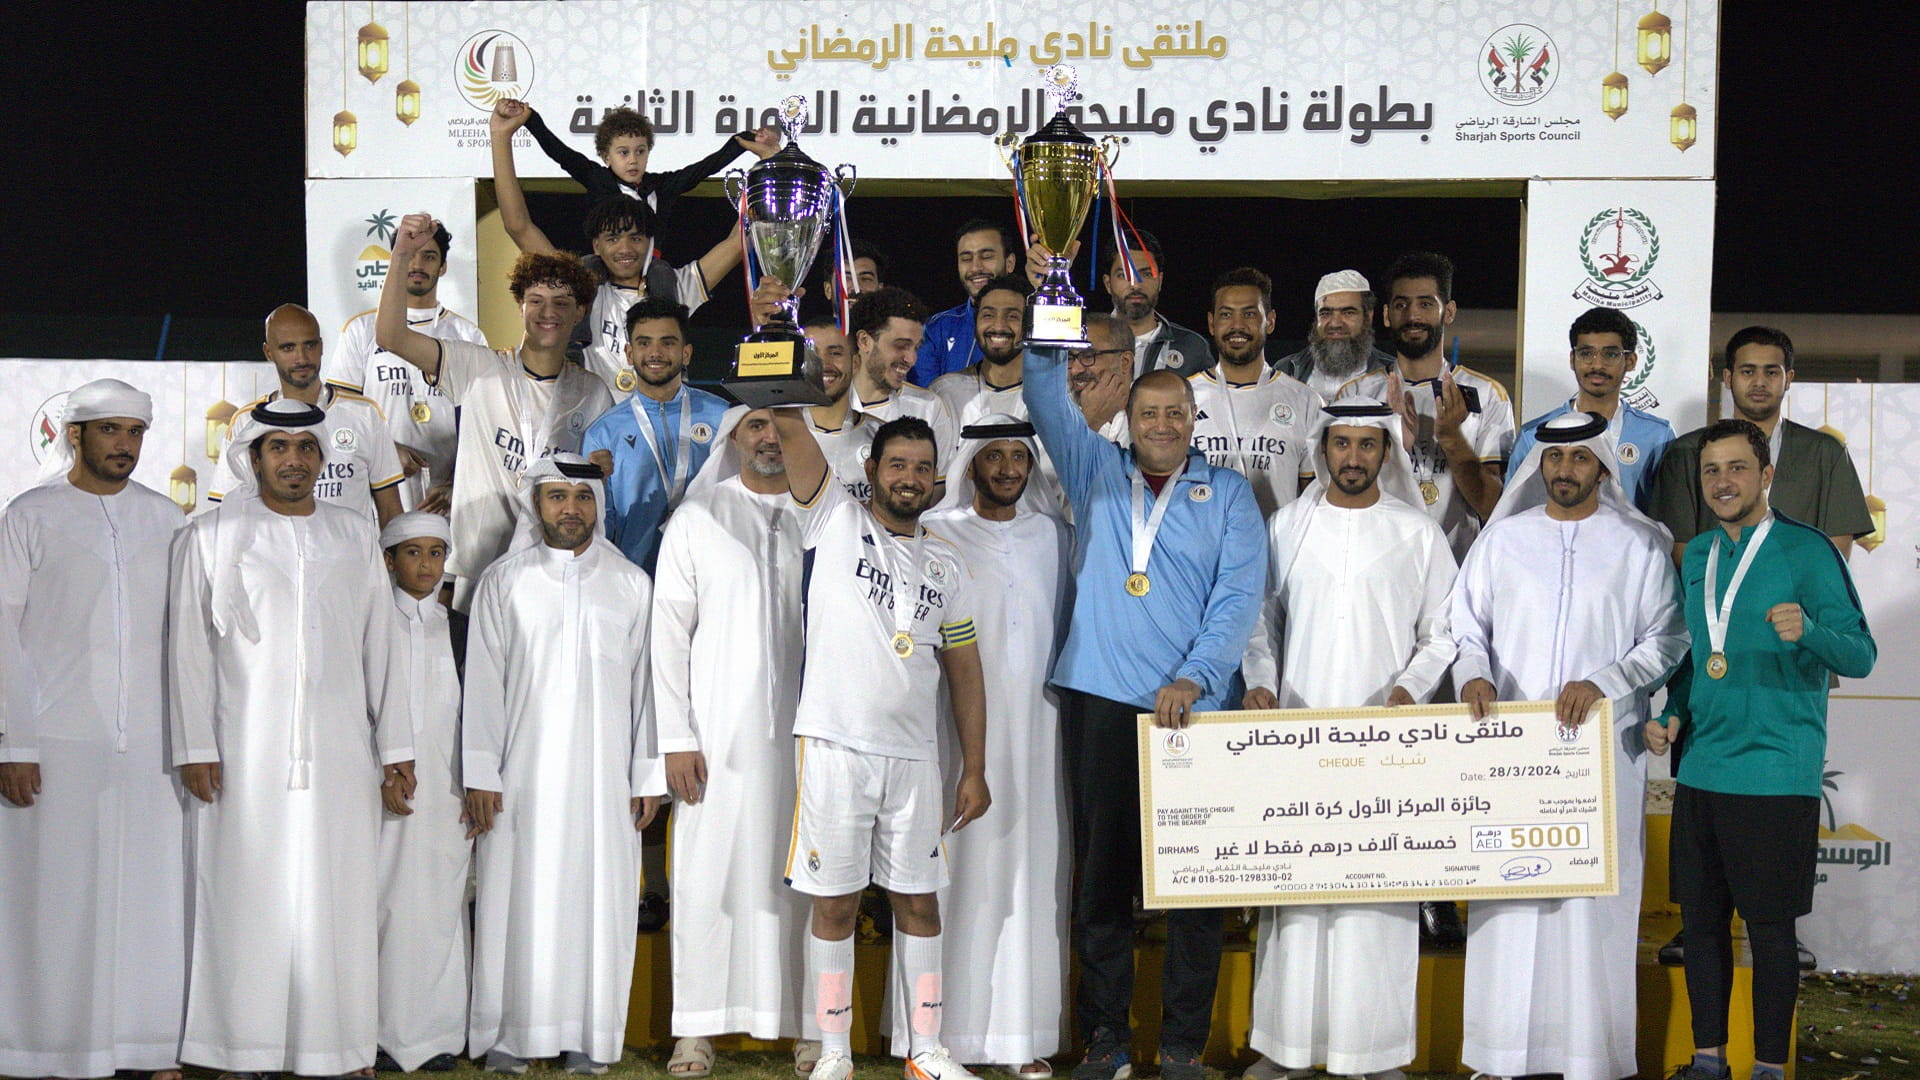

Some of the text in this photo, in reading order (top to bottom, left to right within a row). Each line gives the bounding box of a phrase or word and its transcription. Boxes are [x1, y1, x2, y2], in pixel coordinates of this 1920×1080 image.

[767, 20, 1229, 81] ملتقى نادي مليحة الرمضاني
[852, 88, 1046, 146] الرمضانية
[1188, 86, 1289, 154] نادي
[1303, 85, 1433, 145] بطولة
[1455, 116, 1580, 130] مجلس الشارقة الرياضي
[448, 129, 487, 138] MLEEHA
[1455, 131, 1580, 143] Sharjah Sports Council
[457, 140, 532, 148] & SPOR LUB
[390, 382, 407, 396] FLY
[1193, 434, 1287, 455] Emrtes
[504, 454, 522, 473] FLY
[314, 482, 343, 498] TTER
[1226, 721, 1524, 756] ملتقى نادي مليحة الرمضاني
[1318, 757, 1366, 768] CHEQUE
[1460, 765, 1561, 781] Date: 28/3/2024
[1565, 768, 1590, 780] التاريخ
[1263, 796, 1491, 821] جائزة المركز الأول كرة القدم
[1476, 829, 1502, 838] درهم
[1510, 826, 1581, 848] 5000
[1158, 845, 1200, 855] DIRHAMS
[1214, 833, 1457, 860] خمسة آلاف درهم فقط لا غير
[1476, 838, 1502, 849] AED
[1569, 857, 1599, 868] الإمضاء
[1817, 841, 1891, 872] الوس
[1172, 863, 1292, 875] نادي مليحة الثقافي الرياضي
[1172, 873, 1293, 884] A/C # 018-520-1298330-02
